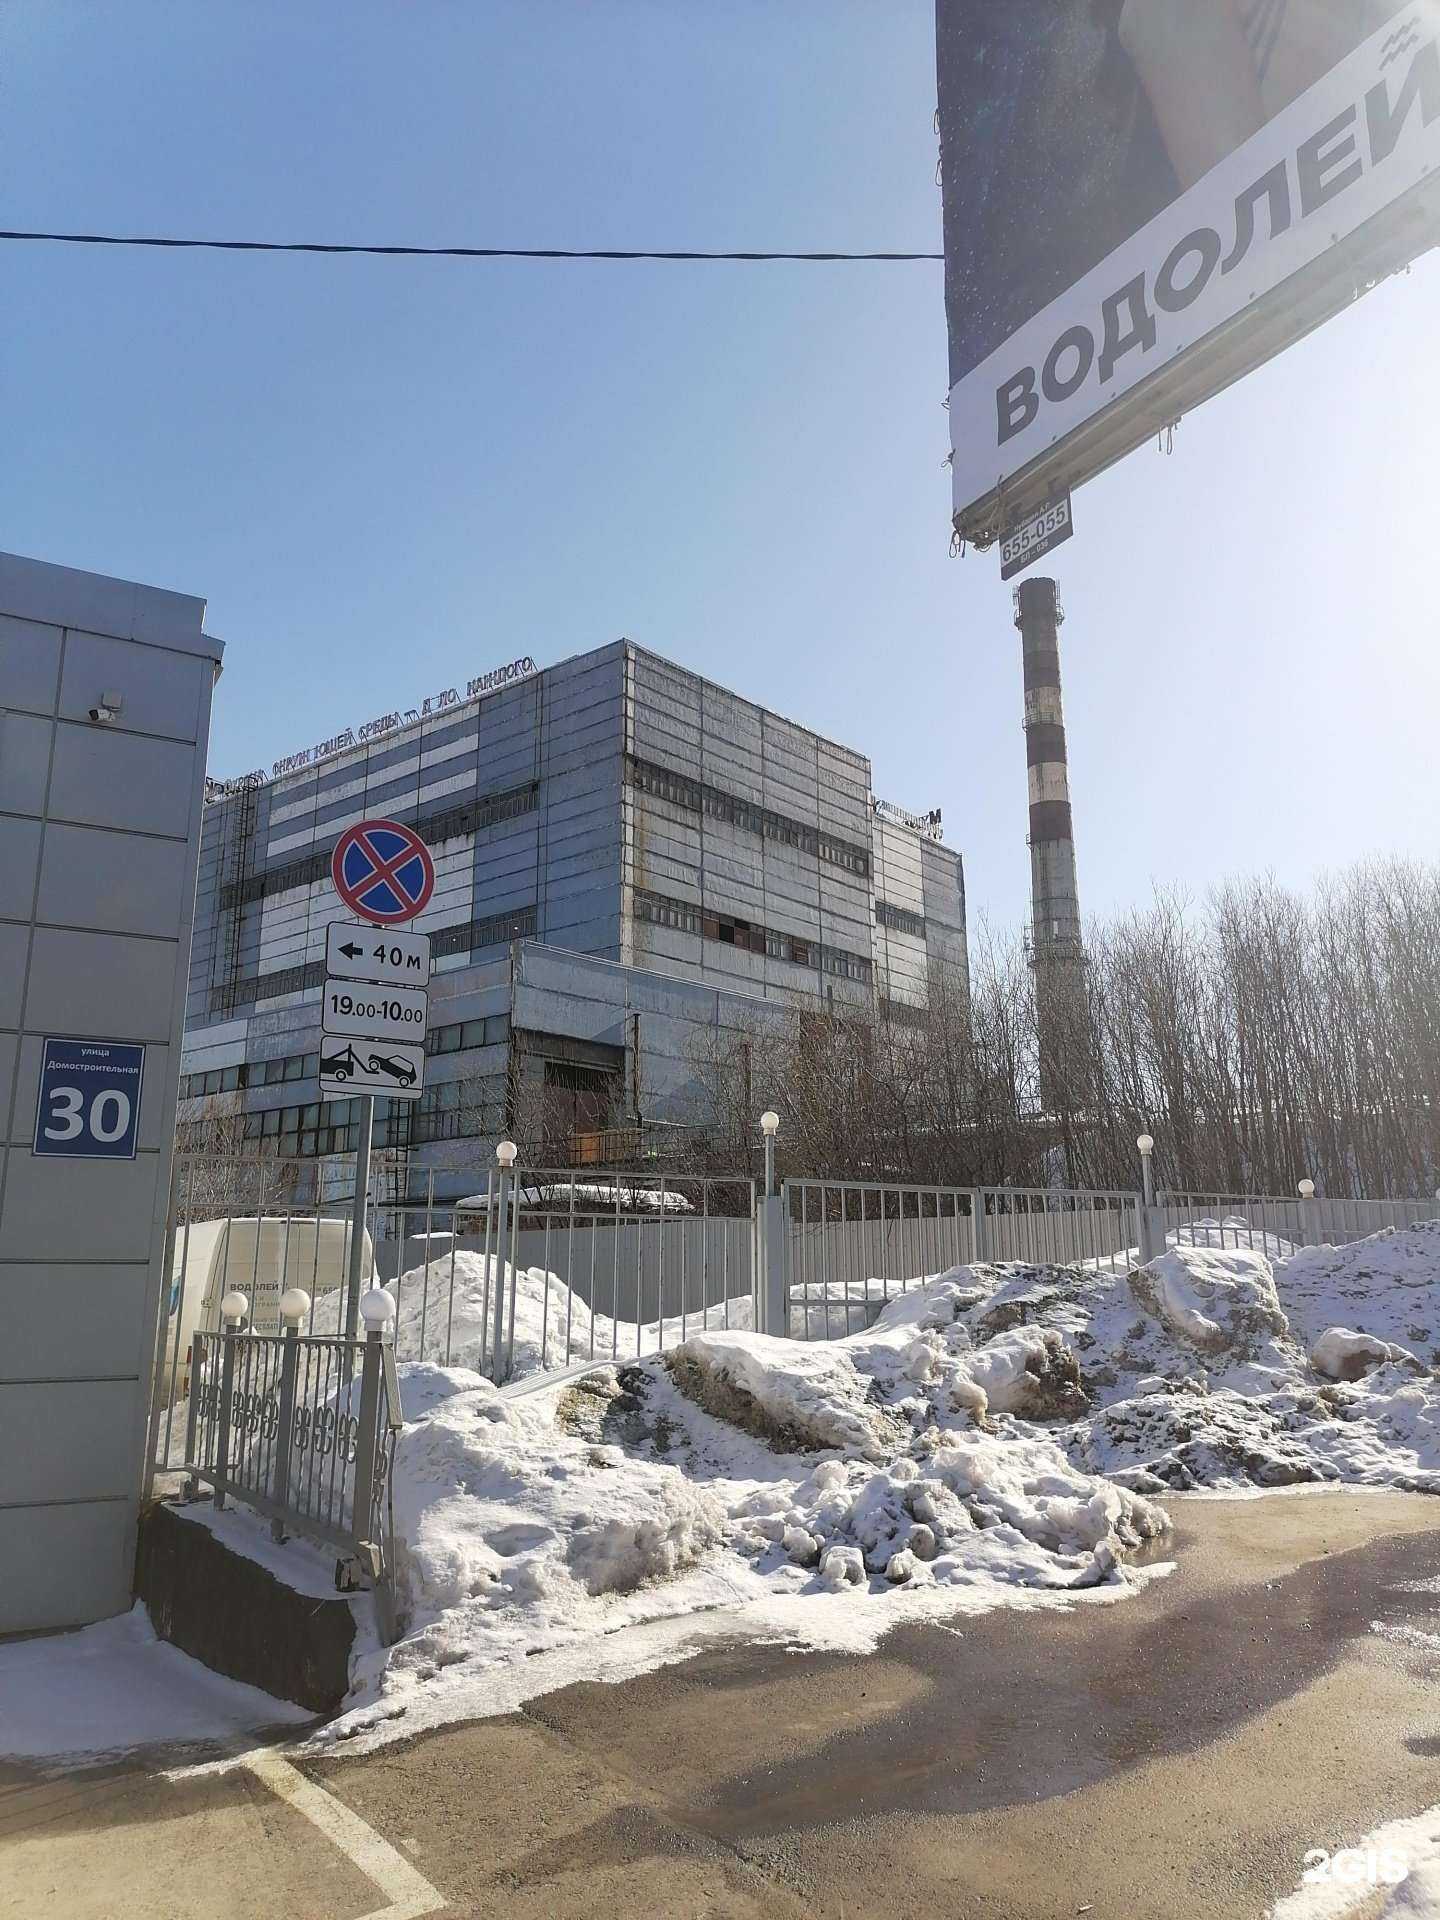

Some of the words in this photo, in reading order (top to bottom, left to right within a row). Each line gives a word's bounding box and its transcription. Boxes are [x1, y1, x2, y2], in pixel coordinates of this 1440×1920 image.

[1003, 504, 1065, 562] 655-055
[358, 711, 399, 737] СРЕДЫ
[467, 656, 533, 697] КАЖДОГО
[373, 944, 403, 966] 40
[331, 994, 423, 1024] 19.00-10.00
[47, 1060, 139, 1074] Домостроительная
[81, 1048, 110, 1057] улица
[44, 1086, 131, 1142] 30
